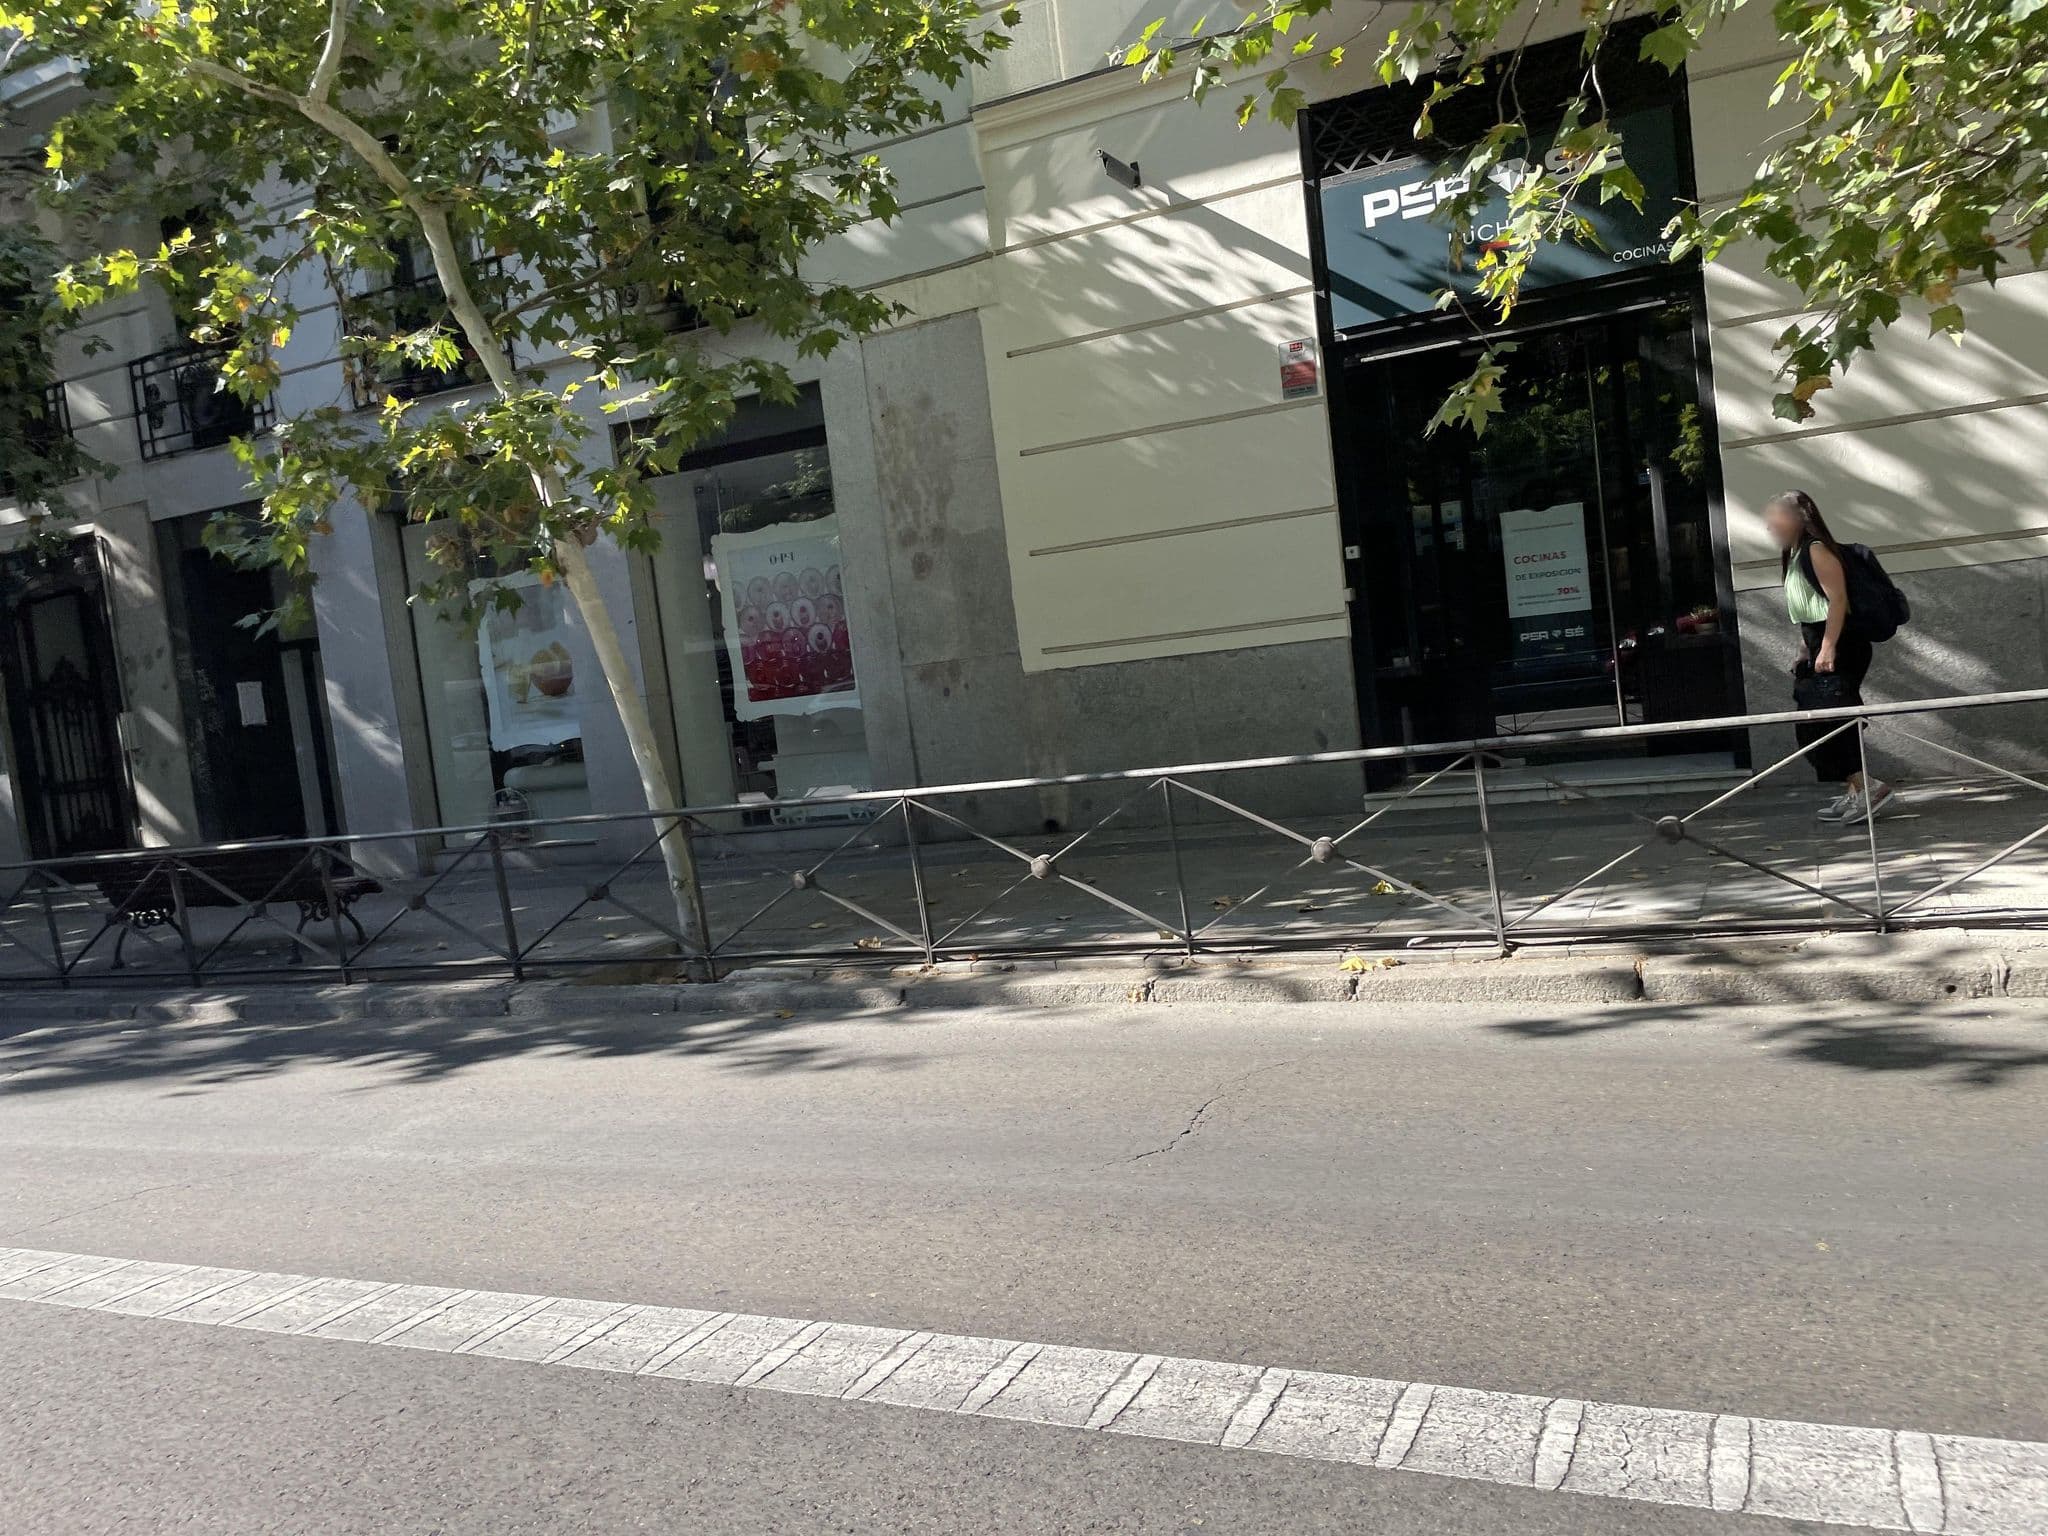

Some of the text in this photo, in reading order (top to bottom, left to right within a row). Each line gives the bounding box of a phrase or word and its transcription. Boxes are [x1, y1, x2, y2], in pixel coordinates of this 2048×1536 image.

[1613, 241, 1674, 262] COCINAS
[1513, 551, 1567, 565] COCINAS
[1515, 573, 1527, 581] DE
[1557, 586, 1580, 595] 70%
[1520, 631, 1549, 642] PER
